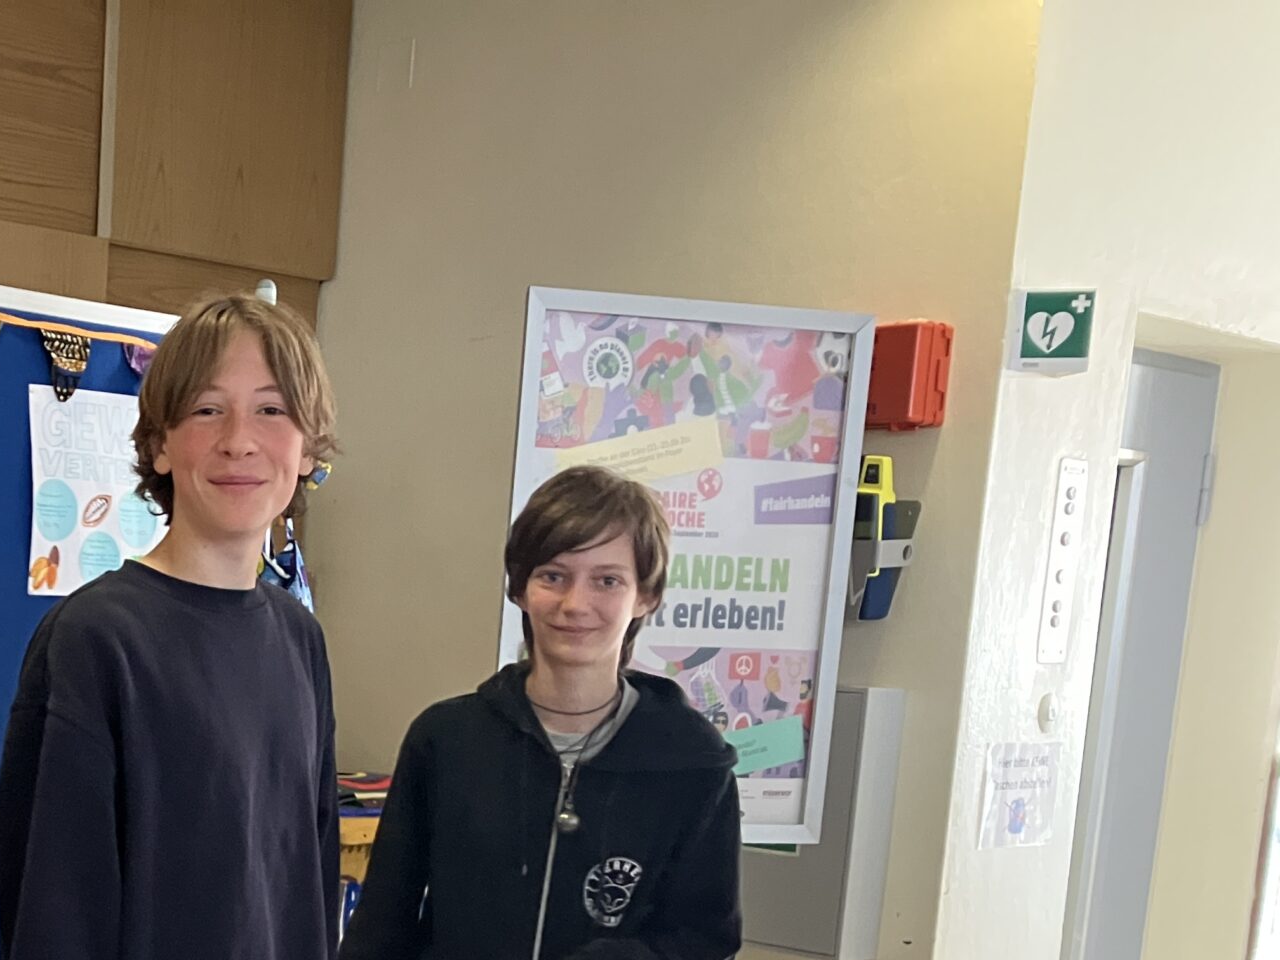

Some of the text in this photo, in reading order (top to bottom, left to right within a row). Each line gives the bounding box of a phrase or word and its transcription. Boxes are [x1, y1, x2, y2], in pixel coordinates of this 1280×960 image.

[42, 400, 137, 455] GEW
[39, 448, 133, 484] VERTE
[660, 491, 698, 509] AIRE
[668, 510, 705, 528] OCHE
[667, 553, 791, 593] ANDELN
[672, 597, 786, 631] erleben!
